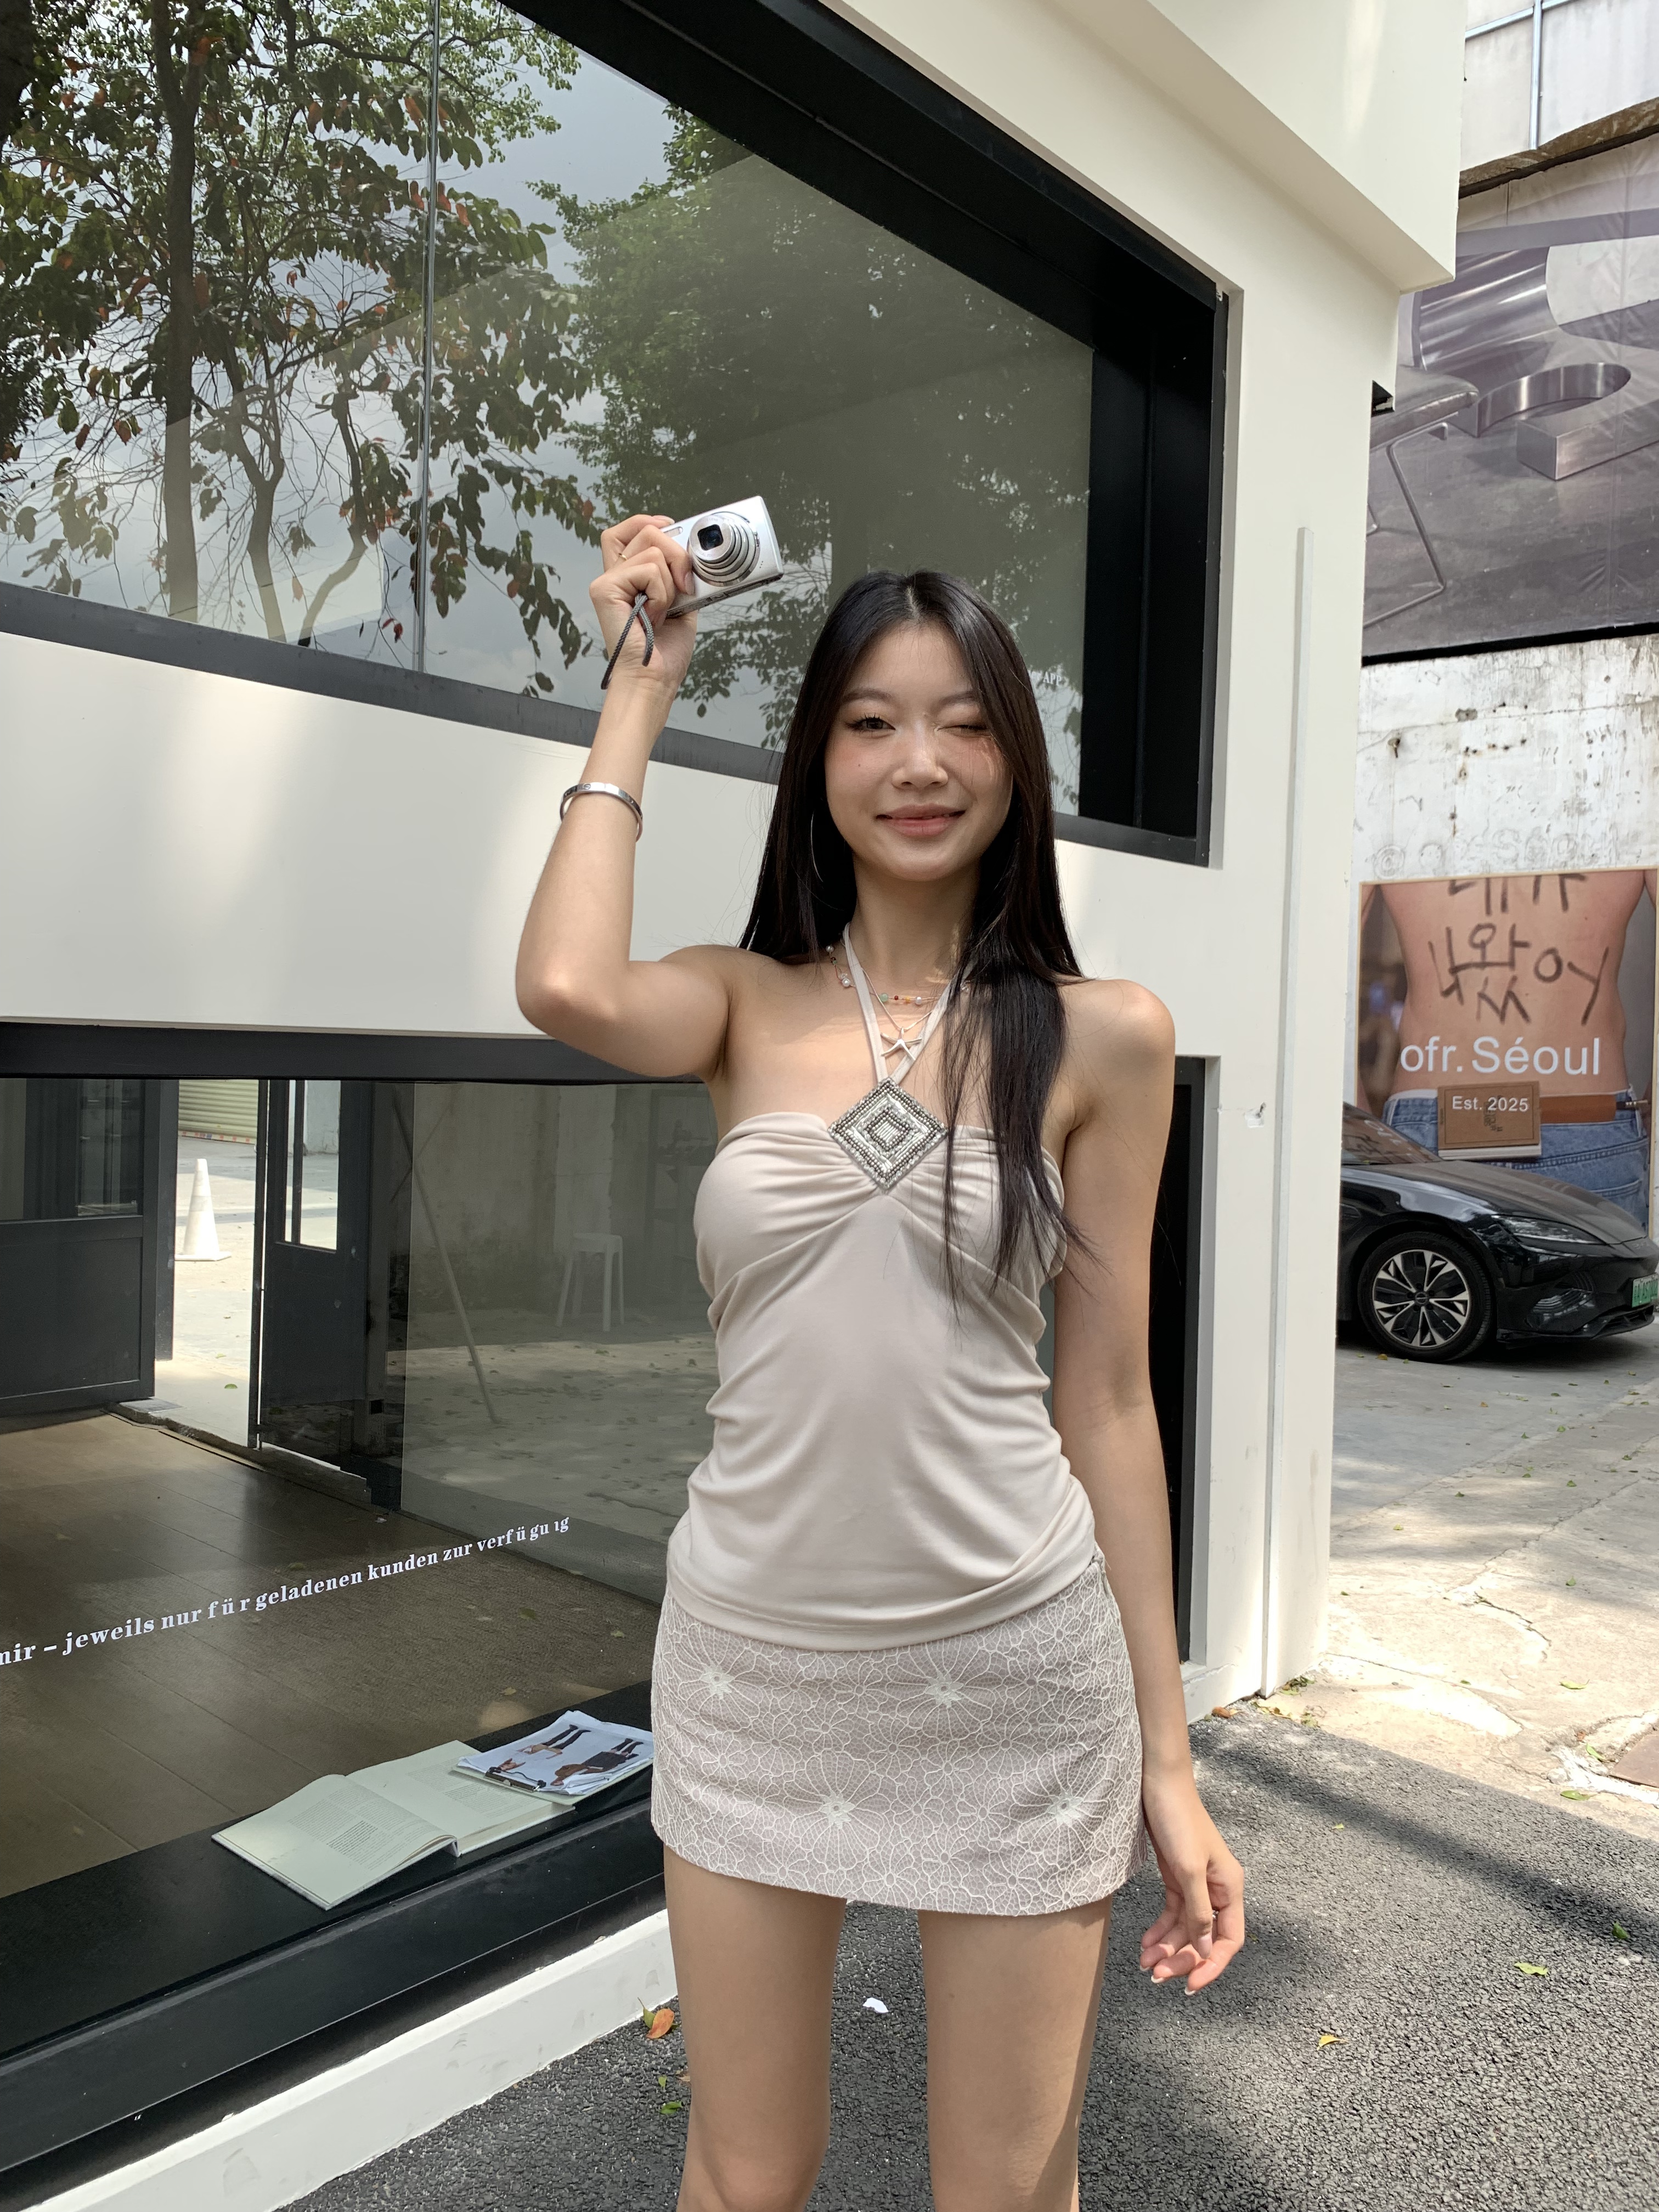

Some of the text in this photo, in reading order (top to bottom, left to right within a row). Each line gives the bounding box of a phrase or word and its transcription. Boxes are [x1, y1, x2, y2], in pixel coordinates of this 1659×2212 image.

[1452, 1096, 1529, 1113] Est. 2025
[62, 1617, 155, 1656] jeweils
[161, 1609, 202, 1630] nur
[207, 1598, 250, 1619] für
[255, 1572, 363, 1611] geladenen
[368, 1553, 438, 1581] kunden
[443, 1543, 473, 1561] zur
